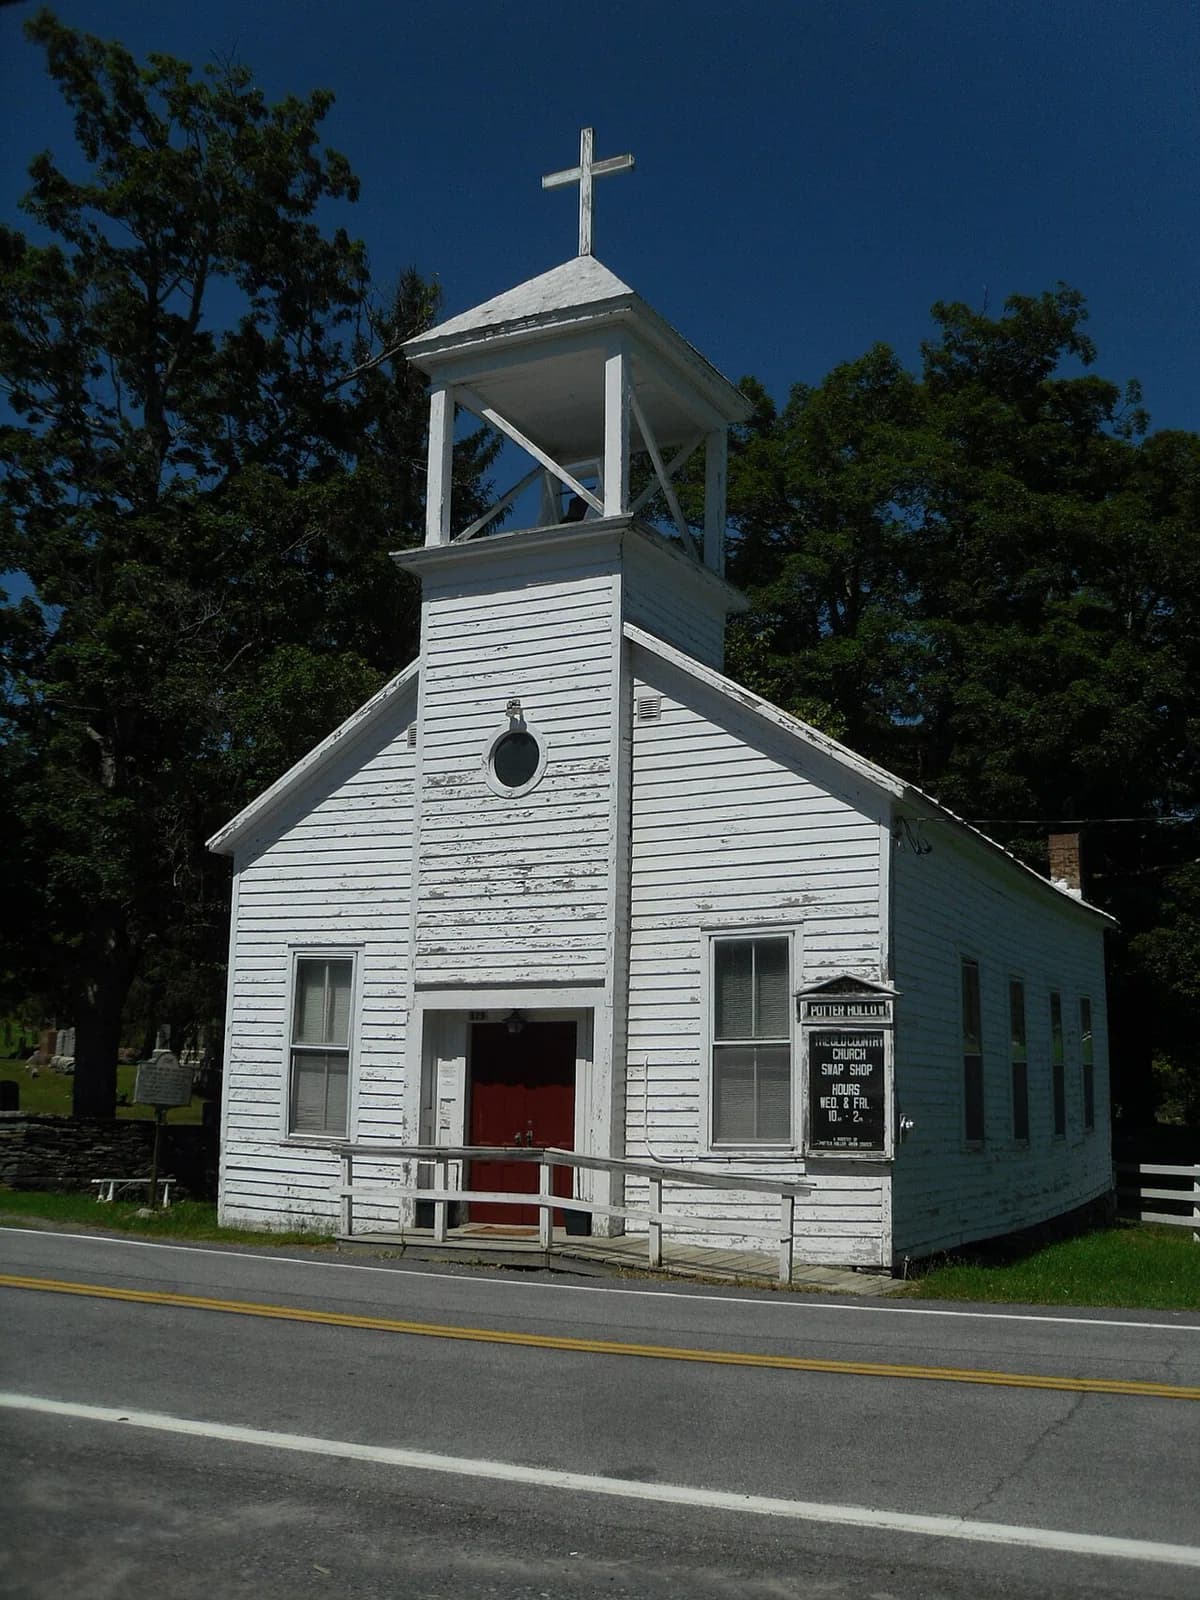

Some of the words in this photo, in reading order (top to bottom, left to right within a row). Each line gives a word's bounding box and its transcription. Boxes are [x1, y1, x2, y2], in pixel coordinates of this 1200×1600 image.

[811, 1005, 844, 1017] POTTER
[847, 1034, 883, 1048] COUNTRY
[832, 1048, 866, 1061] CHURCH
[821, 1063, 844, 1076] SWAP
[849, 1063, 873, 1076] SHOP
[832, 1083, 861, 1096] HOURS
[843, 1096, 849, 1109] &
